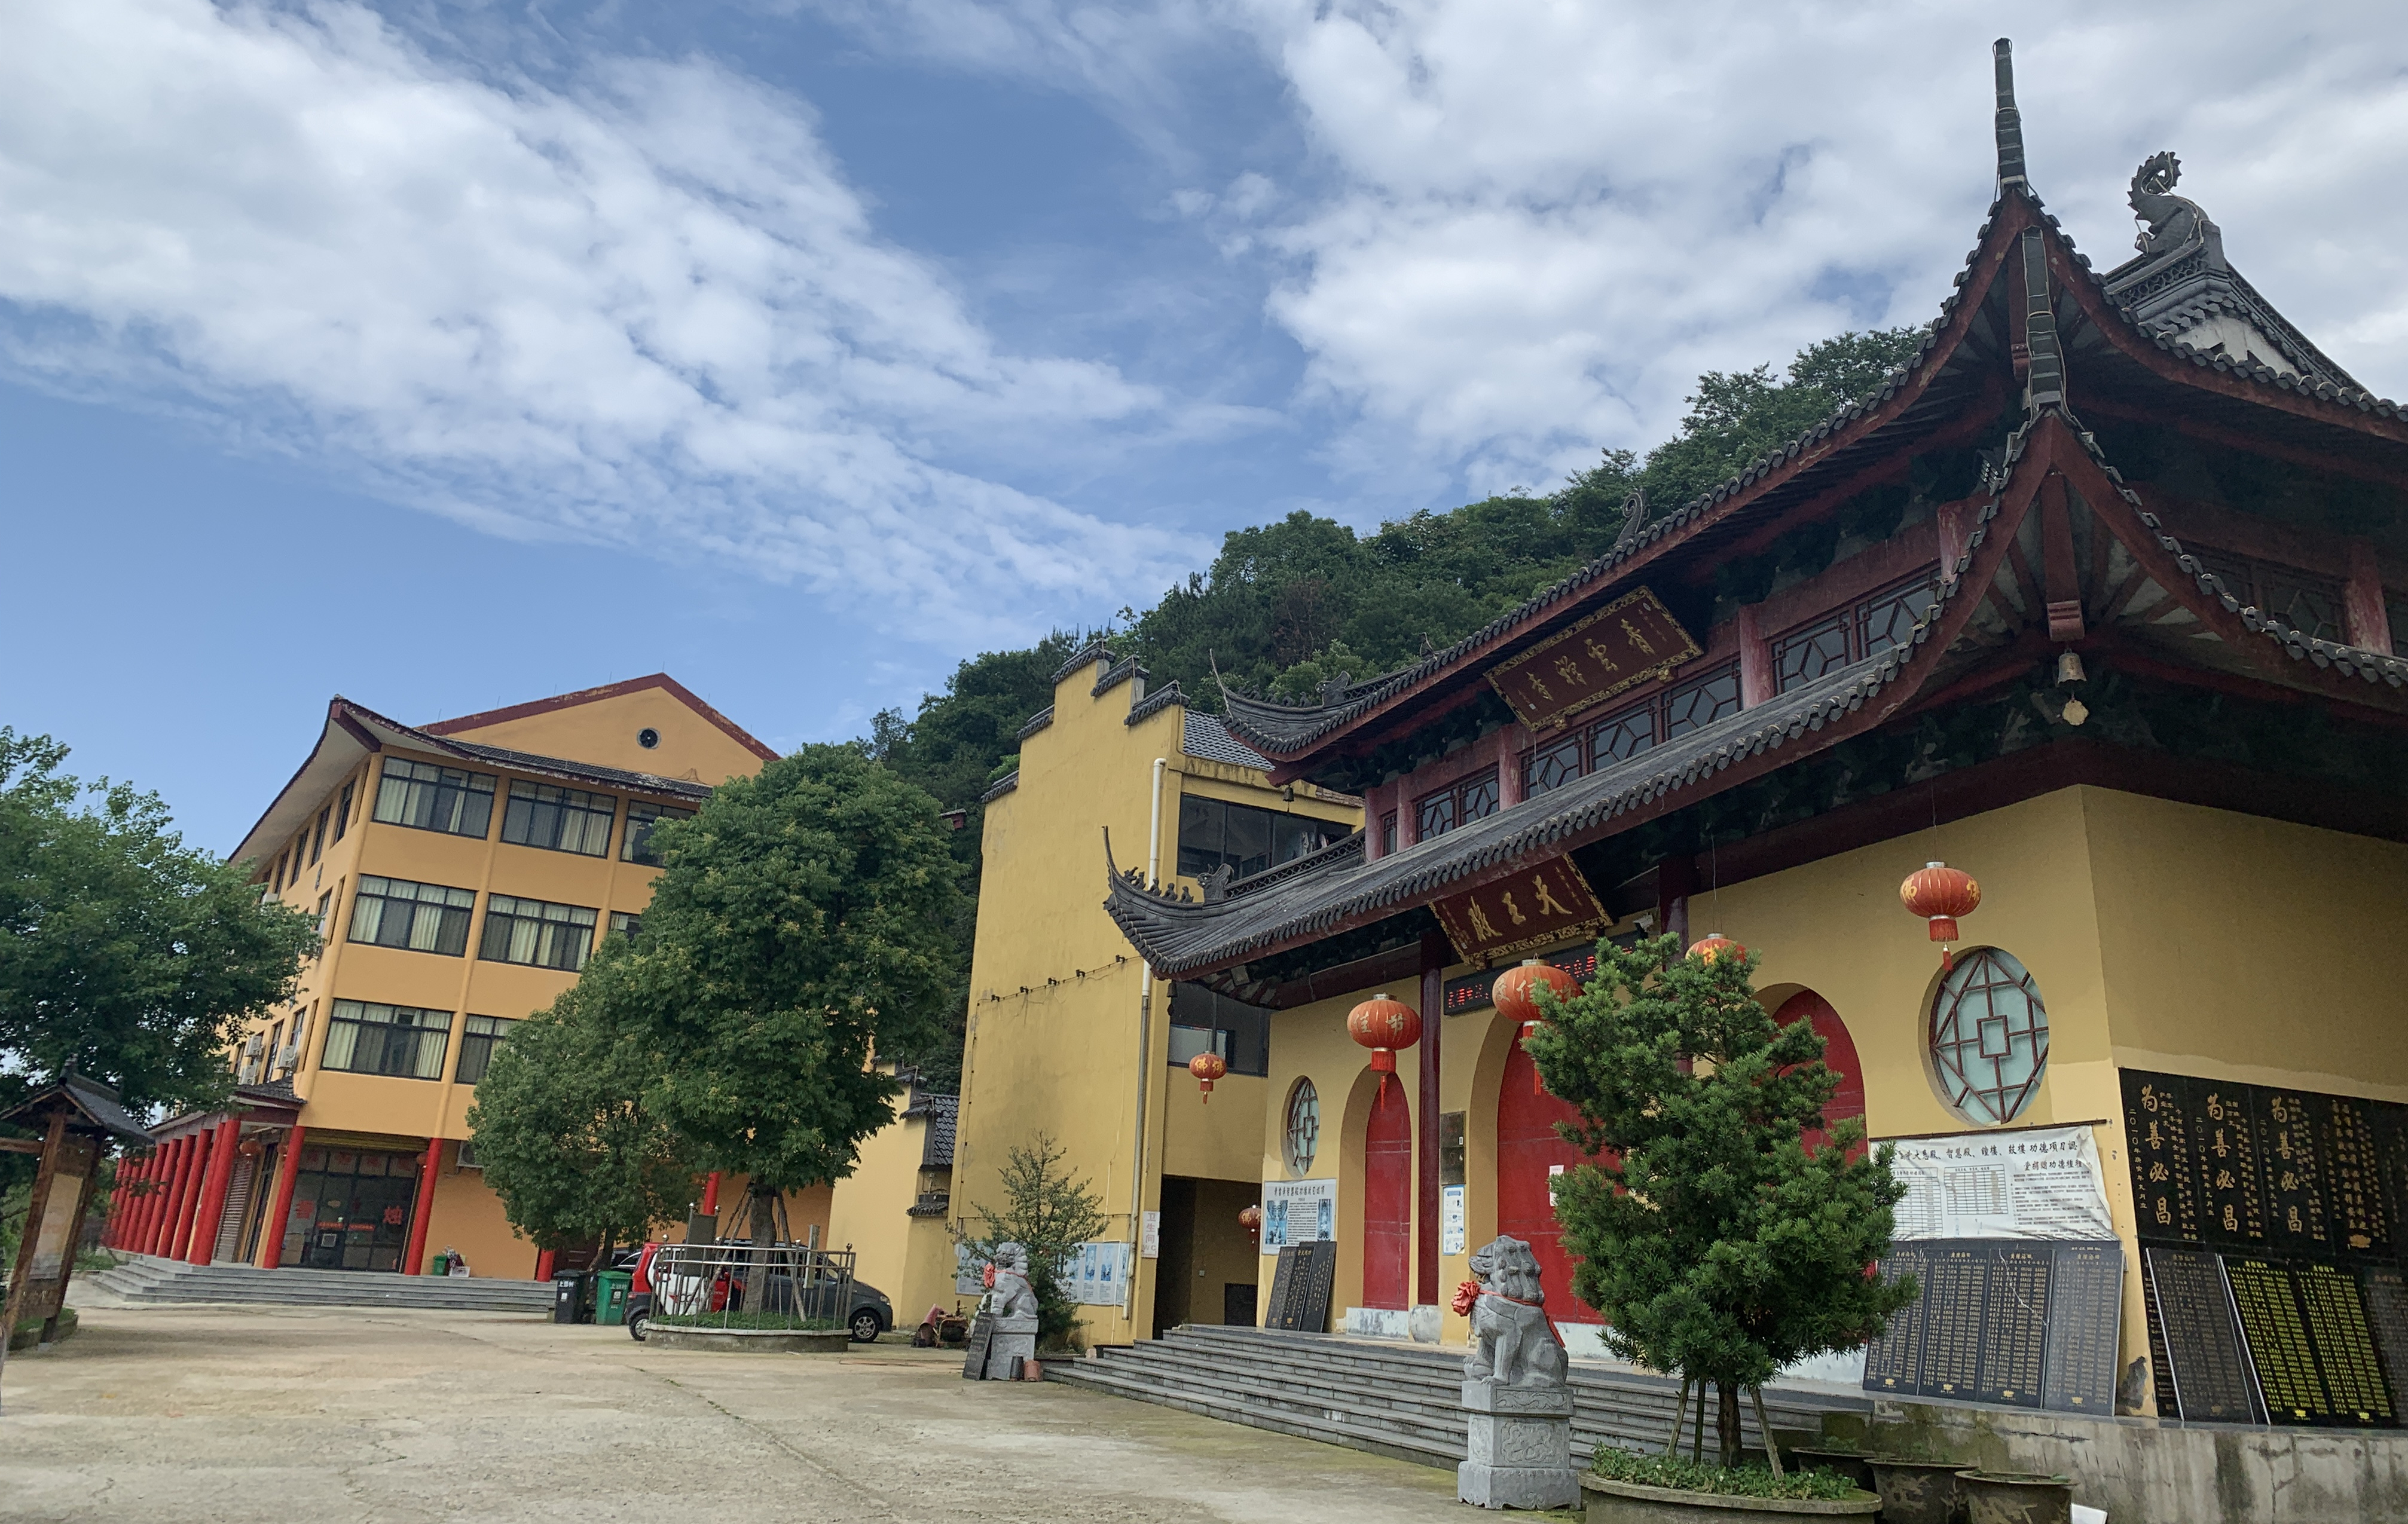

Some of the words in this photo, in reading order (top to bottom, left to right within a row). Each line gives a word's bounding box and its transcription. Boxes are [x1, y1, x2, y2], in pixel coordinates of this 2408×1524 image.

[2141, 1084, 2171, 1225] 为善必昌
[2207, 1092, 2238, 1232] 为善必昌
[2272, 1096, 2303, 1232] 为善必昌
[1145, 1212, 1156, 1244] 卫生间
